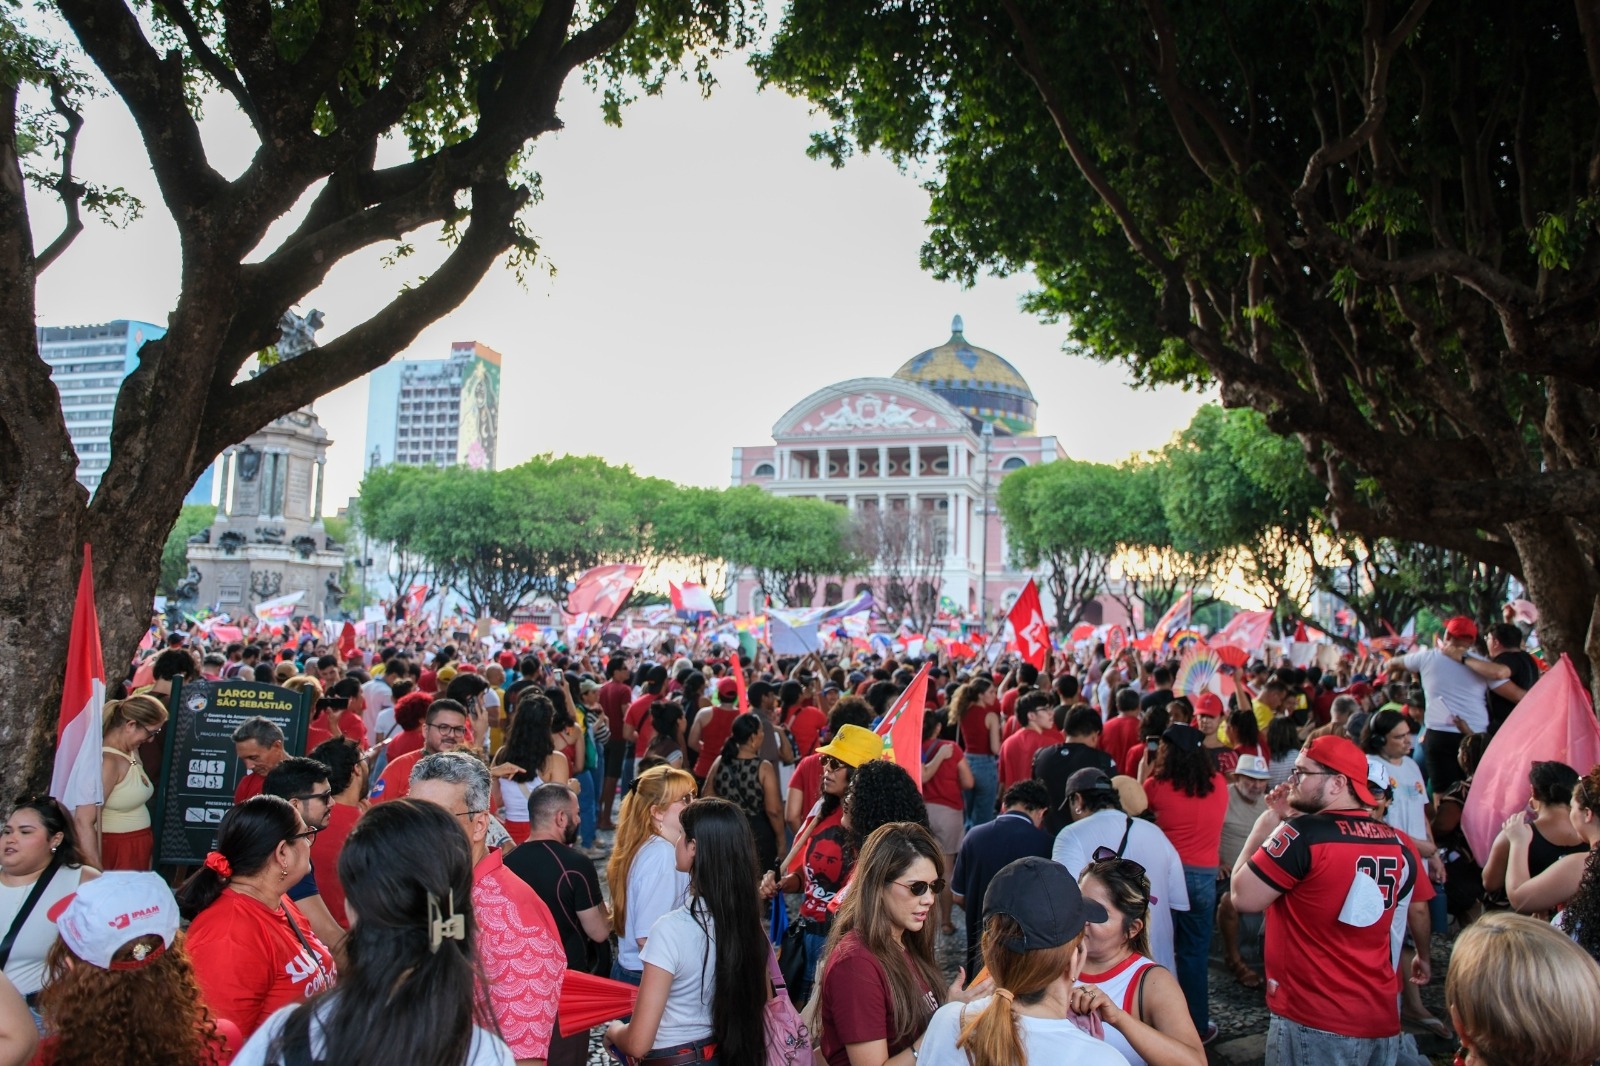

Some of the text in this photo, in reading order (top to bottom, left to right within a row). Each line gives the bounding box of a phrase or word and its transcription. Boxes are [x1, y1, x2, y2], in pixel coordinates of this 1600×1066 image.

[217, 688, 274, 700] LARGO DE
[216, 697, 293, 711] SÃO SEBASTIÃO
[1335, 820, 1396, 838] FLAMENG
[131, 905, 160, 919] IPAAM
